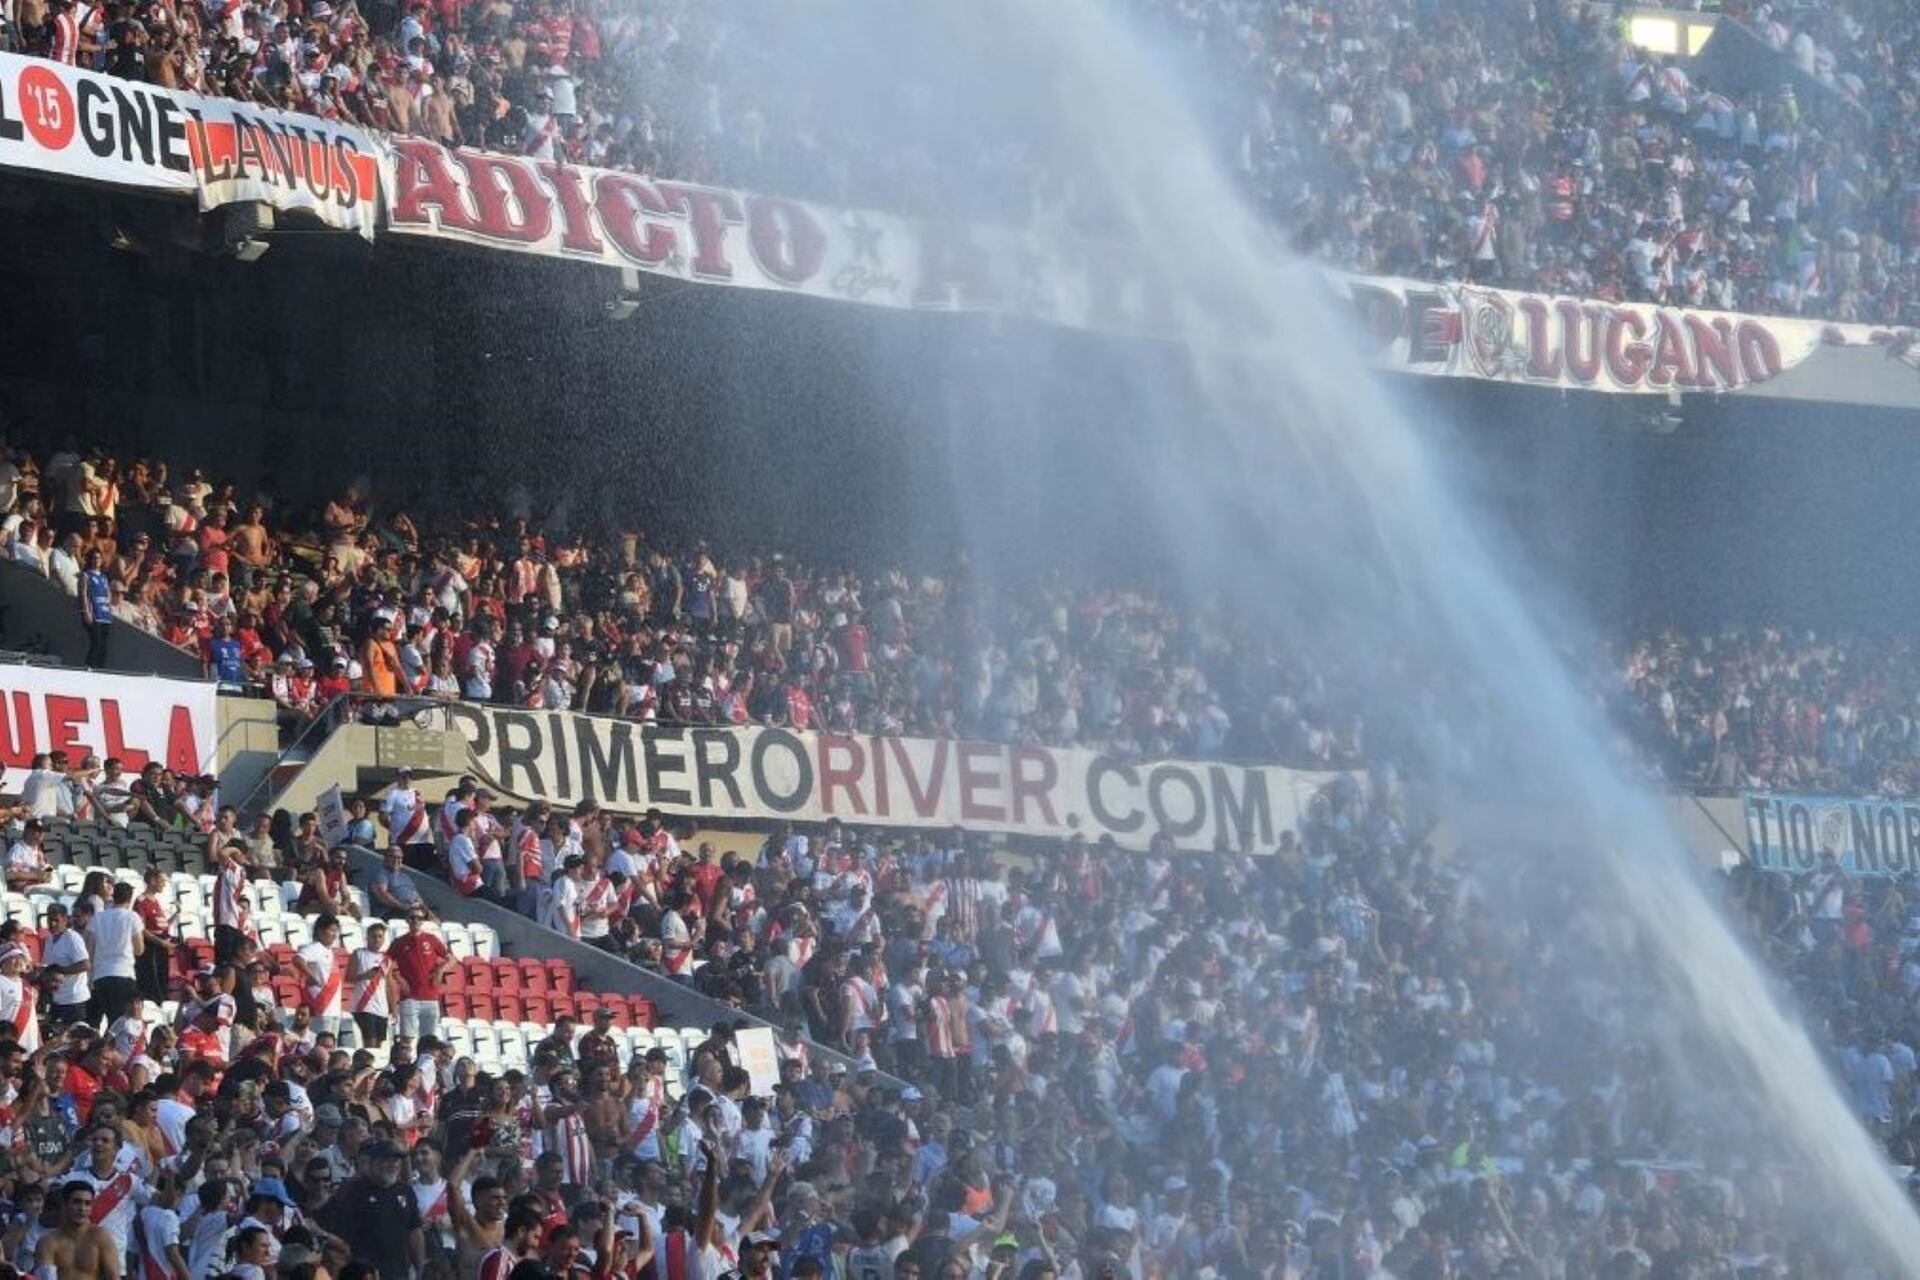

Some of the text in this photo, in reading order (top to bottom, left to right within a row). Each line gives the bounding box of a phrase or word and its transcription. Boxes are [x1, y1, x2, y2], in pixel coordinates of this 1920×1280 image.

[185, 107, 358, 209] LANUS
[391, 136, 827, 284] ADICTO
[1519, 297, 1783, 388] LUGANO
[1749, 796, 1815, 868] TIO
